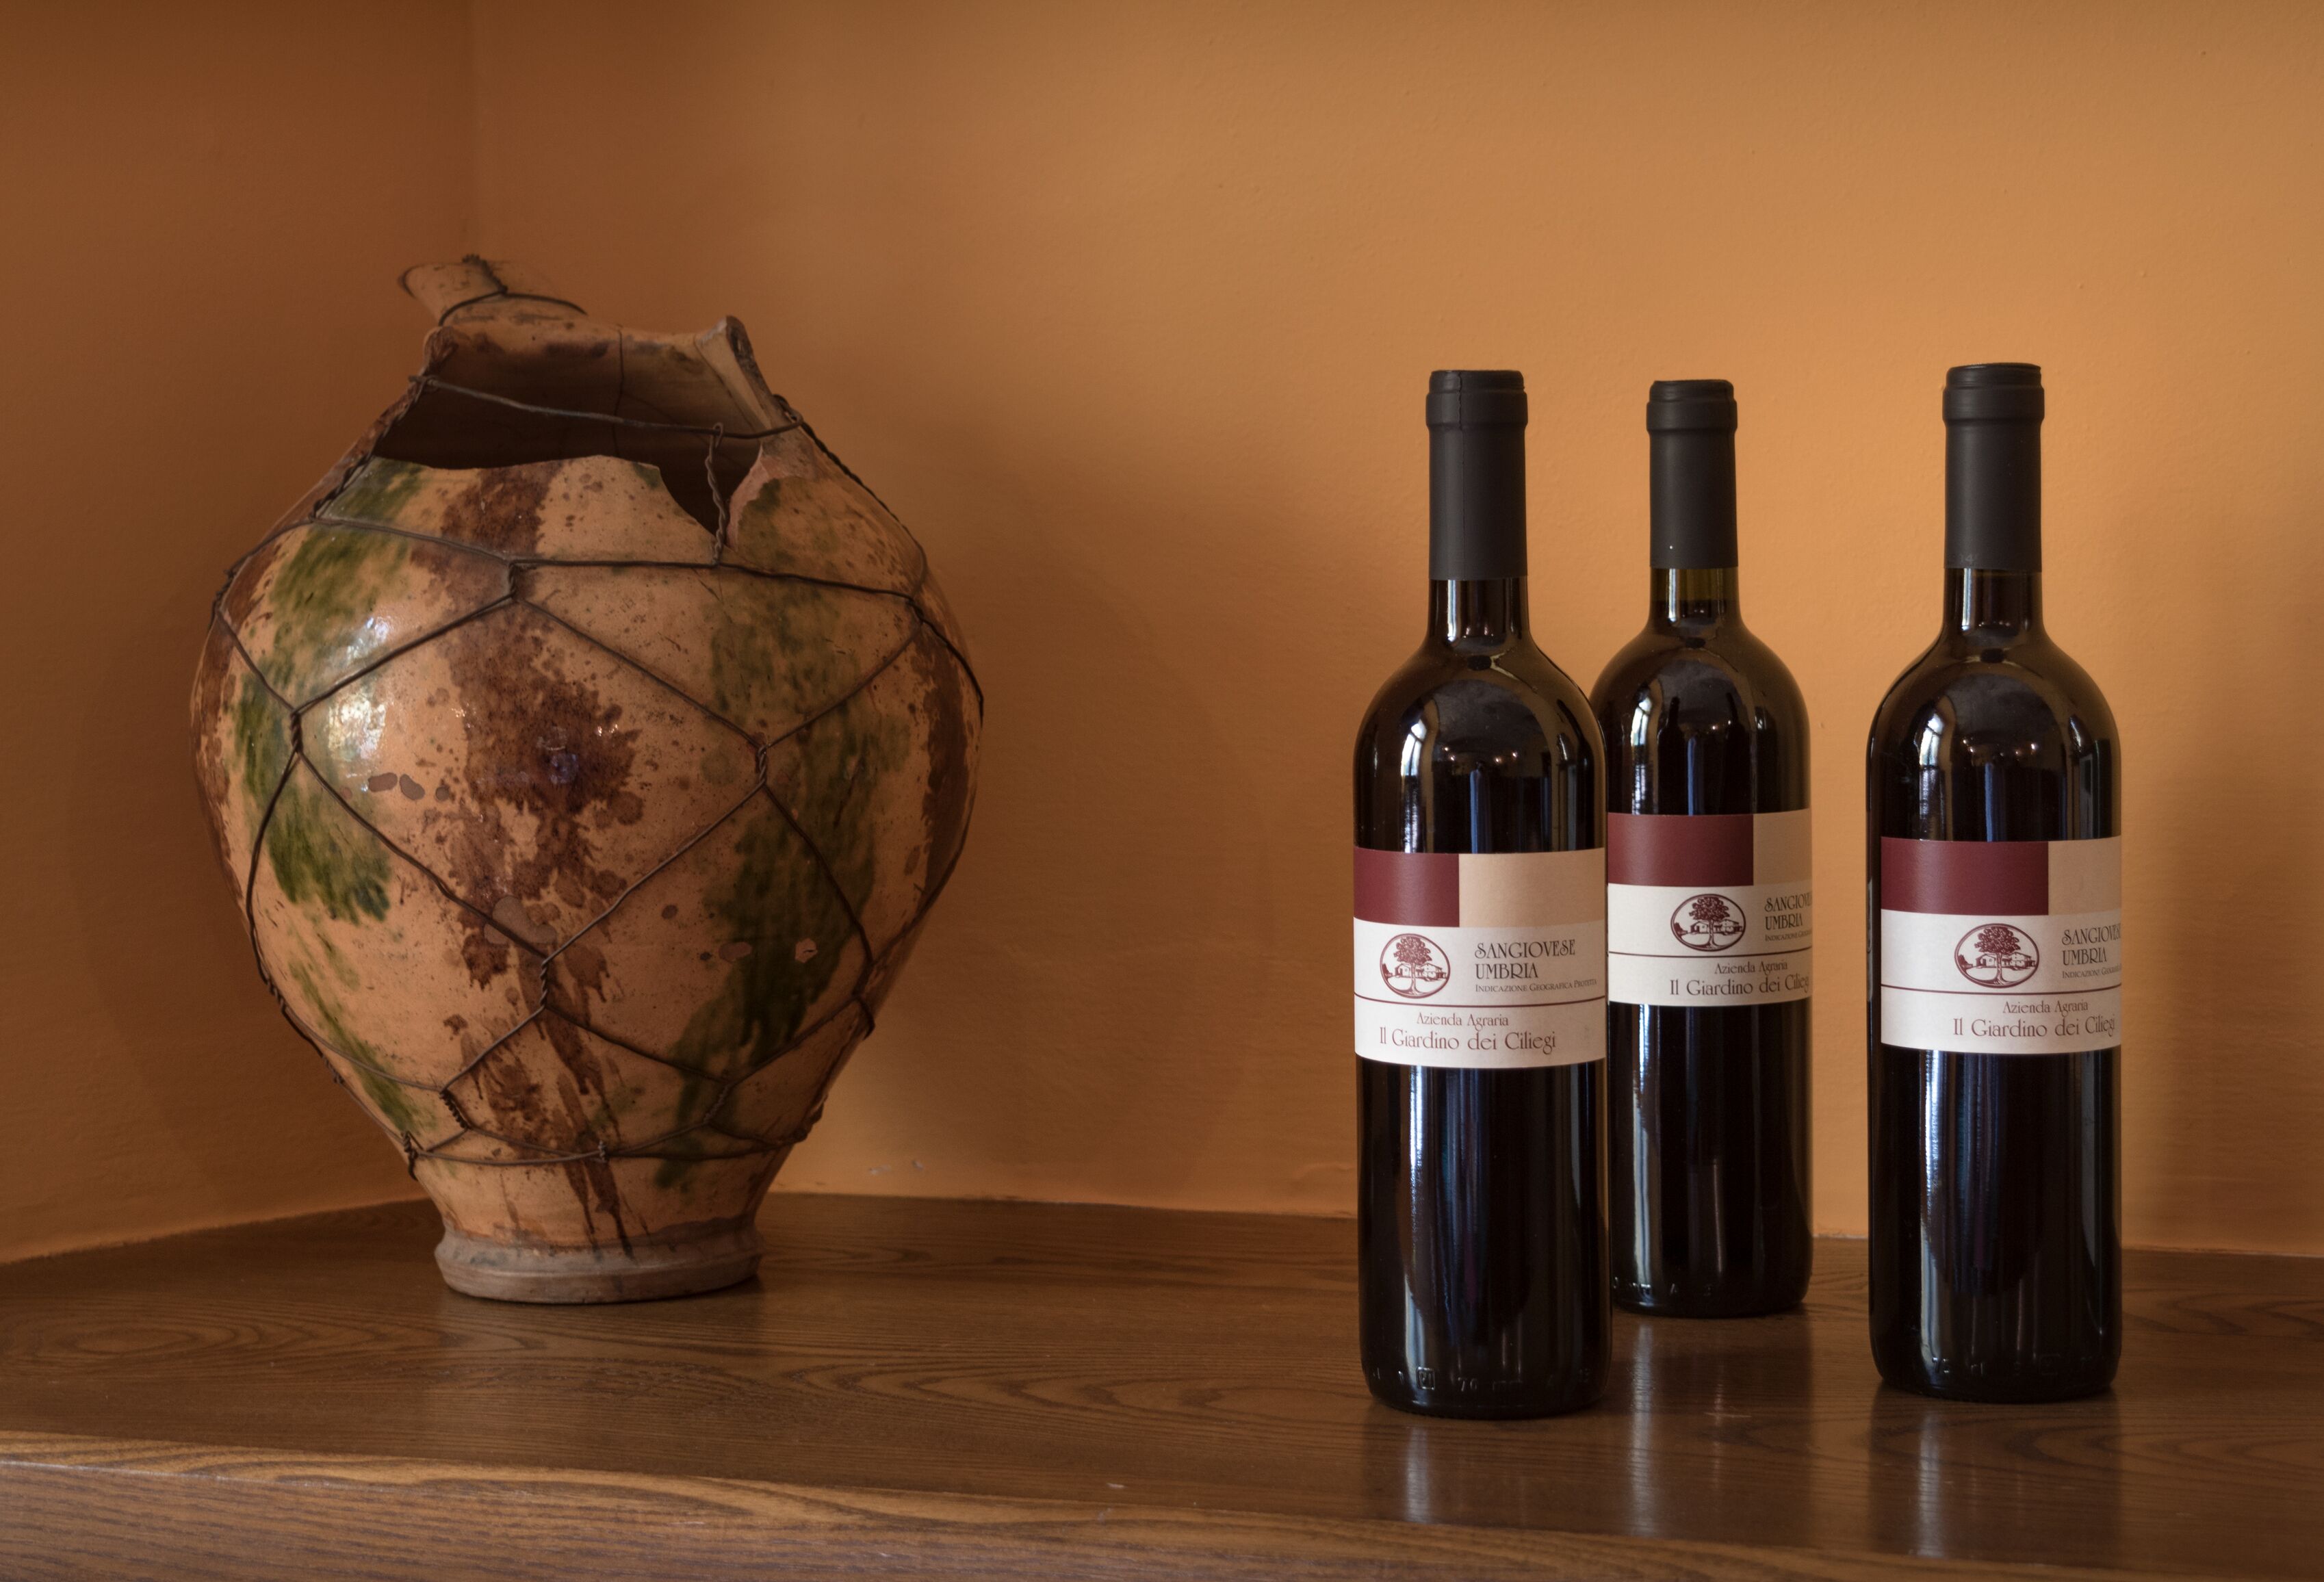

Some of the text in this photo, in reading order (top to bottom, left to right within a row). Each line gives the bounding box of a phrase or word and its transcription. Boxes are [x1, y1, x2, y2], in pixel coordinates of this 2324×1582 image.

[1765, 913, 1803, 931] UMBRIA
[1474, 939, 1576, 959] SANGIOVESE
[2062, 947, 2107, 965] UMBRIA
[1475, 963, 1538, 979] UMBRIA
[1714, 959, 1787, 976] Azienda Agraria
[1670, 978, 1679, 995] Il
[1686, 979, 1753, 996] Giardino
[1759, 976, 1780, 993] dei
[2003, 998, 2089, 1017] Azienda Agraria
[1417, 1012, 1509, 1031] Azienda Agraria
[1953, 1017, 1963, 1035] Il
[1972, 1018, 2048, 1037] Giardino
[2054, 1017, 2080, 1037] dei
[1380, 1027, 1556, 1055] Il Giardino dei Ciliegi
